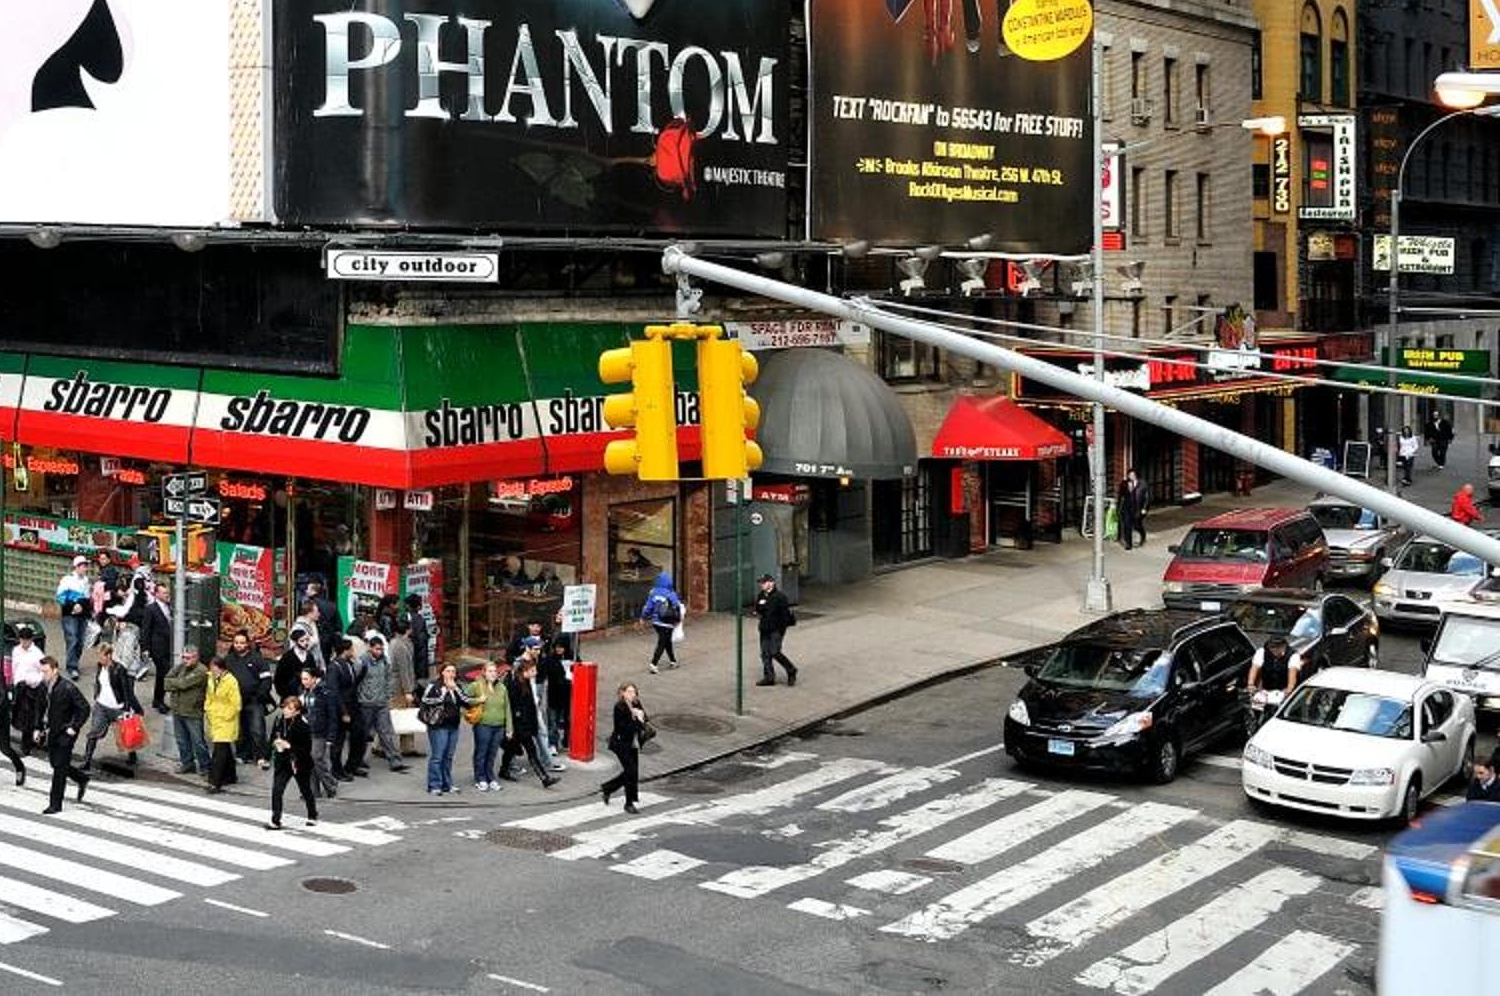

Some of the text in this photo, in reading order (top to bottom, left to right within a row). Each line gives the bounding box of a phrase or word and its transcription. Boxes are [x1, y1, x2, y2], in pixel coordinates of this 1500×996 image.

[312, 10, 779, 145] PHANTOM
[833, 96, 866, 120] TEXT
[937, 107, 949, 127] to
[995, 111, 1012, 133] for
[1014, 113, 1043, 135] FREE
[351, 255, 478, 276] city outdoor
[44, 370, 172, 423] sbarro
[221, 390, 371, 443] sbarro
[426, 388, 602, 448] sbarro sbar
[27, 456, 79, 475] Espresso
[795, 463, 817, 474] 701
[219, 479, 266, 500] Salads
[761, 491, 789, 501] ATM
